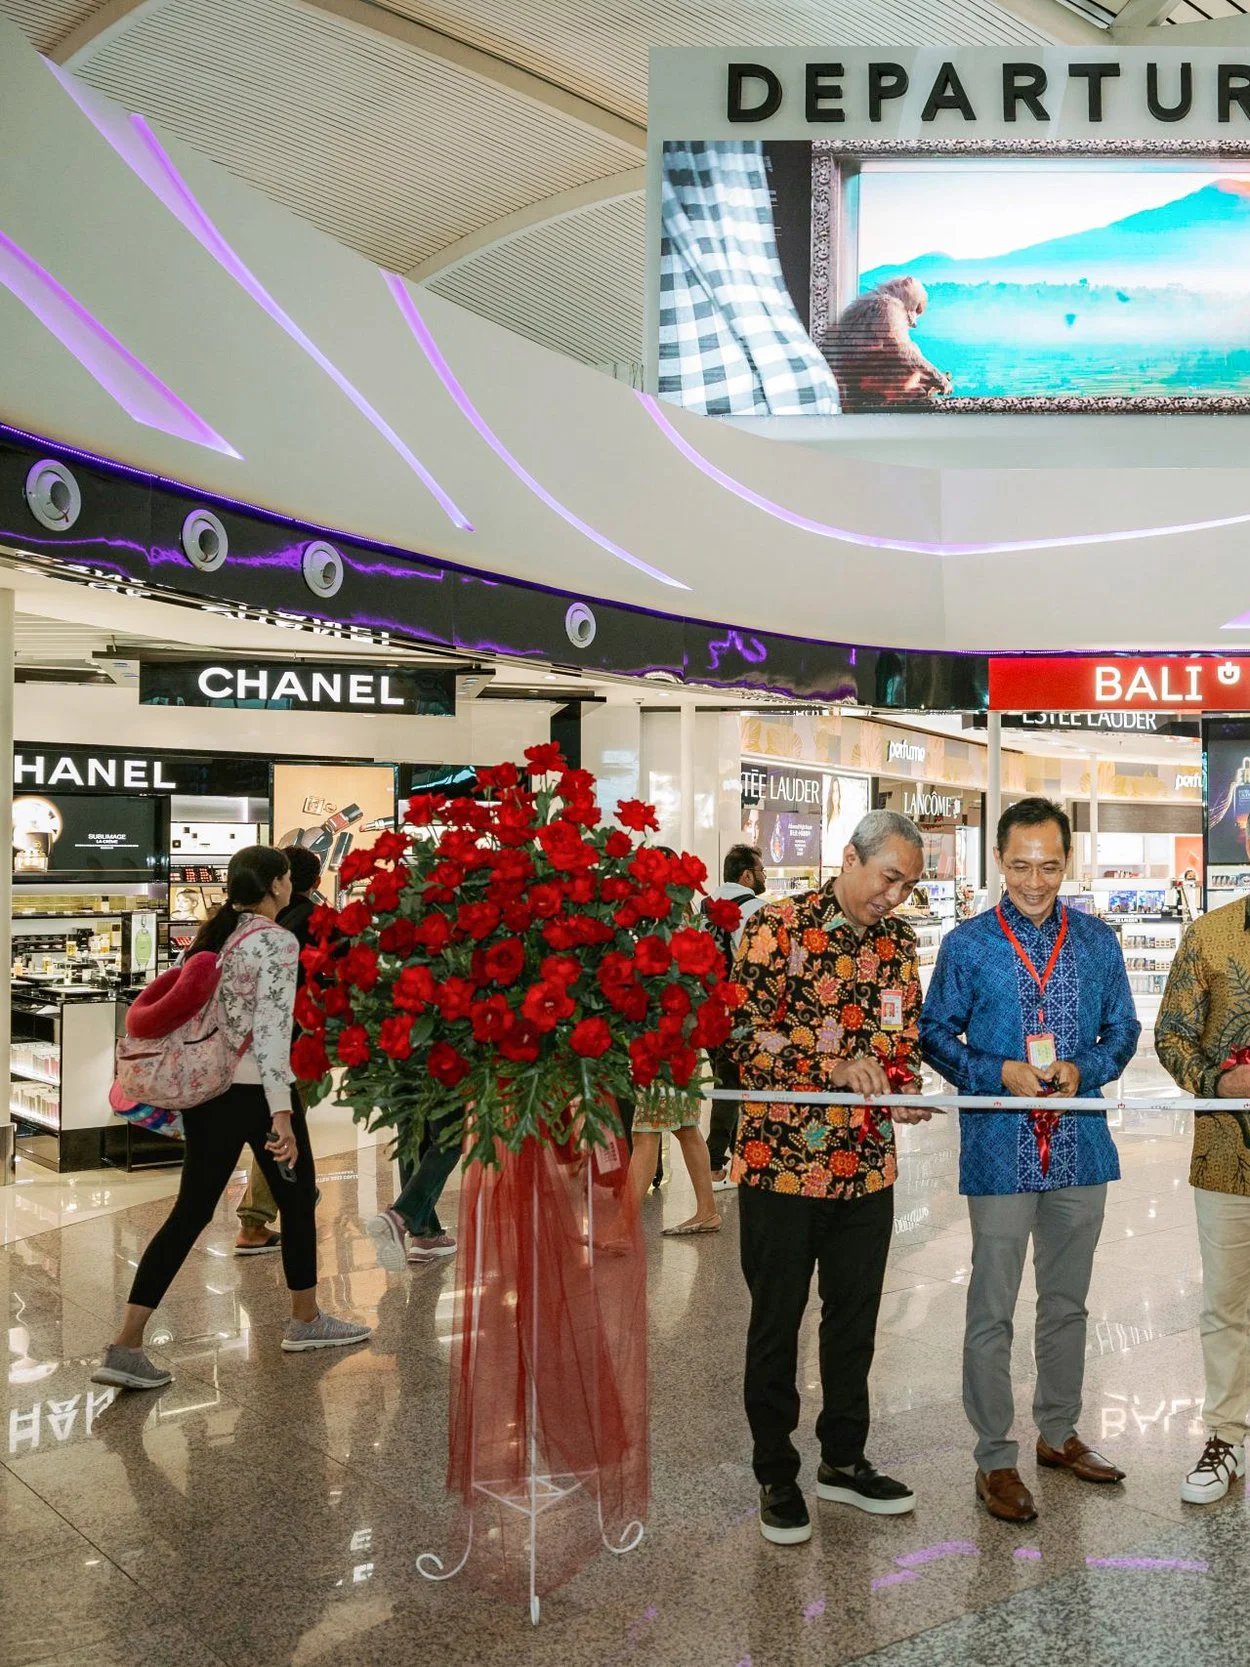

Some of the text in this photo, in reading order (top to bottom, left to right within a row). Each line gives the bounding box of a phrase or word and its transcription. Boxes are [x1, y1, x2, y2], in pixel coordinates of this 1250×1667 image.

[198, 666, 405, 706] CHANEL
[1094, 665, 1203, 702] BALI
[1087, 712, 1157, 731] LAUDER
[770, 775, 820, 805] LAUDER
[904, 791, 953, 818] LANCÔME
